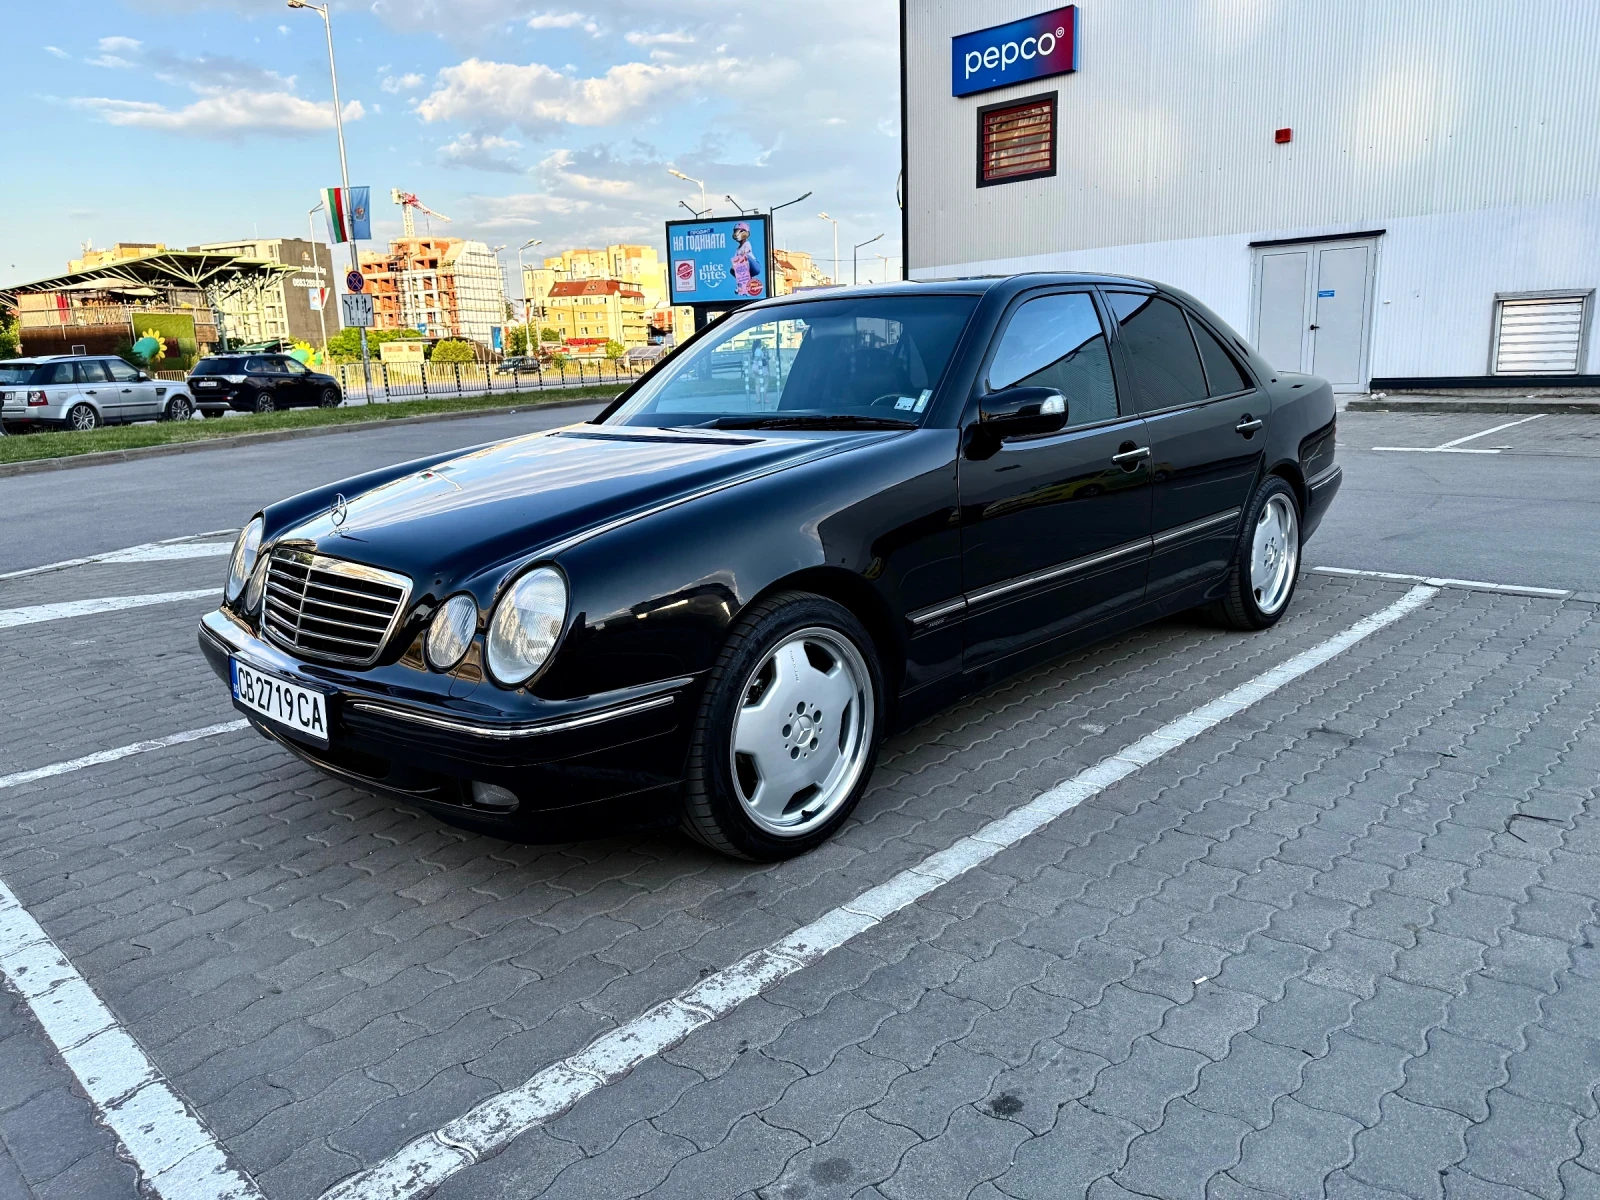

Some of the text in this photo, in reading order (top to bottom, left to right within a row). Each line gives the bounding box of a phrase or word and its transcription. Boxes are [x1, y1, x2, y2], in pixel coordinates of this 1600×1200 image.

[965, 32, 1056, 80] pepco
[673, 233, 725, 252] НА ГОДИНАТА
[702, 262, 724, 272] nice
[699, 269, 727, 283] bites
